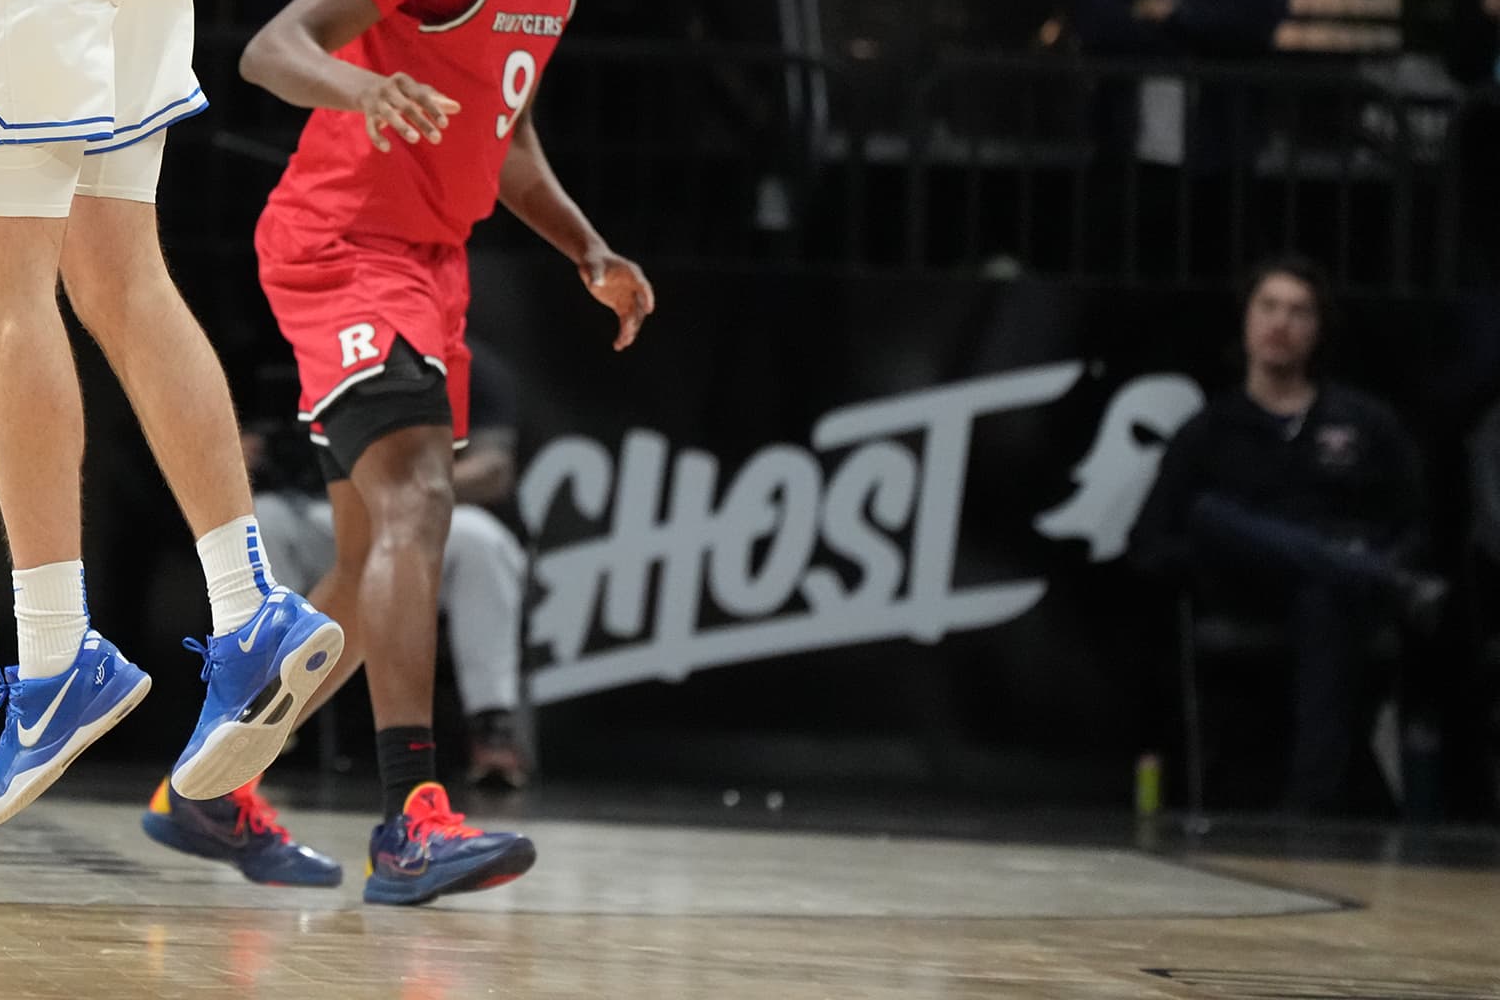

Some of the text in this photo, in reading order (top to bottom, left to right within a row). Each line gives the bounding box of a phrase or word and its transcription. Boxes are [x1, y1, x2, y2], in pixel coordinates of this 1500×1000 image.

[492, 11, 564, 37] RUTGERS
[496, 49, 537, 140] 9
[338, 322, 380, 369] R
[520, 361, 1083, 702] GHOST
